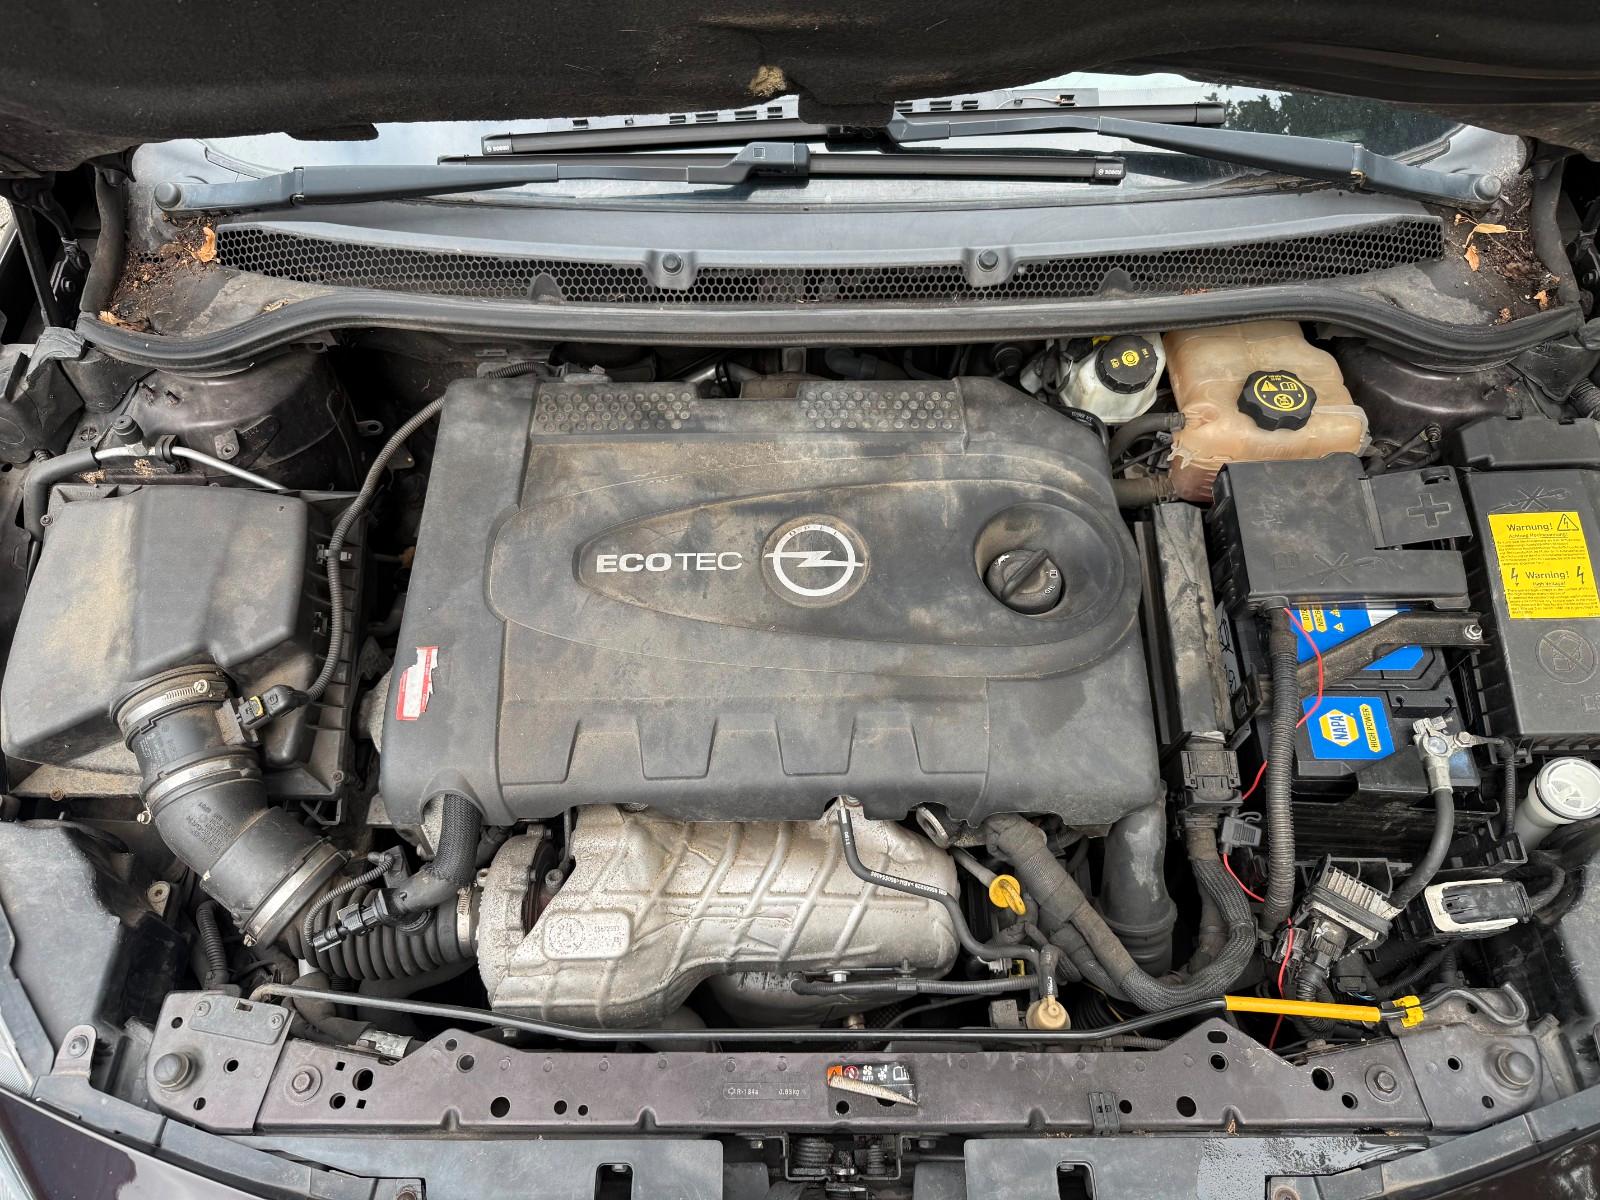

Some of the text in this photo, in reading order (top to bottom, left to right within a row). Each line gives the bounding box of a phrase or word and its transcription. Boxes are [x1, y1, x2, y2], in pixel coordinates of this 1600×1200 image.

[1507, 523, 1553, 531] Warnung!
[596, 551, 743, 573] ECOTEC
[1525, 571, 1570, 579] Warning!
[1329, 715, 1349, 740] NAPA
[1362, 708, 1379, 748] HIGH POWER
